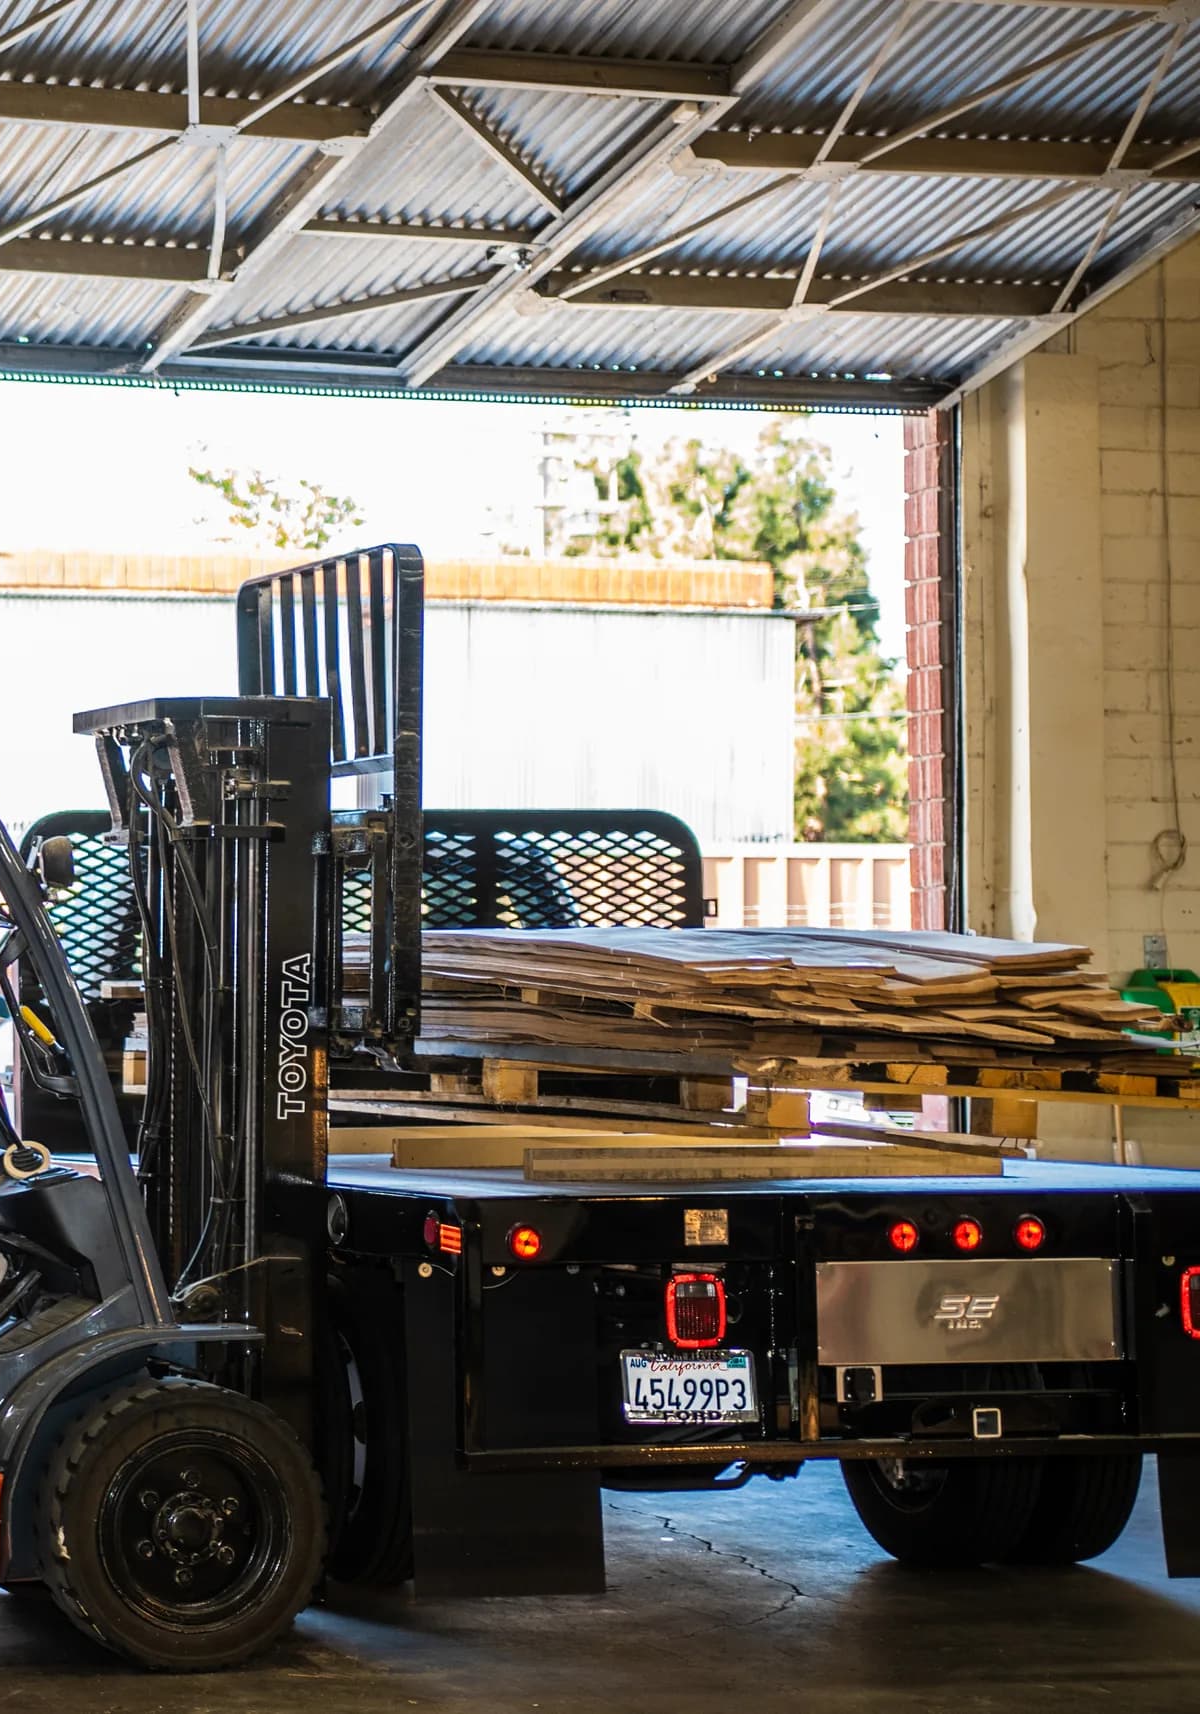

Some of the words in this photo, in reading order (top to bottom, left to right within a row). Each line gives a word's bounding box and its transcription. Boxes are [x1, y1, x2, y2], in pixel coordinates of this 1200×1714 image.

[277, 953, 311, 1120] TOYOTA
[933, 1294, 999, 1319] SE
[630, 1358, 648, 1368] AUG
[650, 1360, 726, 1376] California
[634, 1378, 747, 1410] 45499P3
[663, 1410, 722, 1423] FORD
